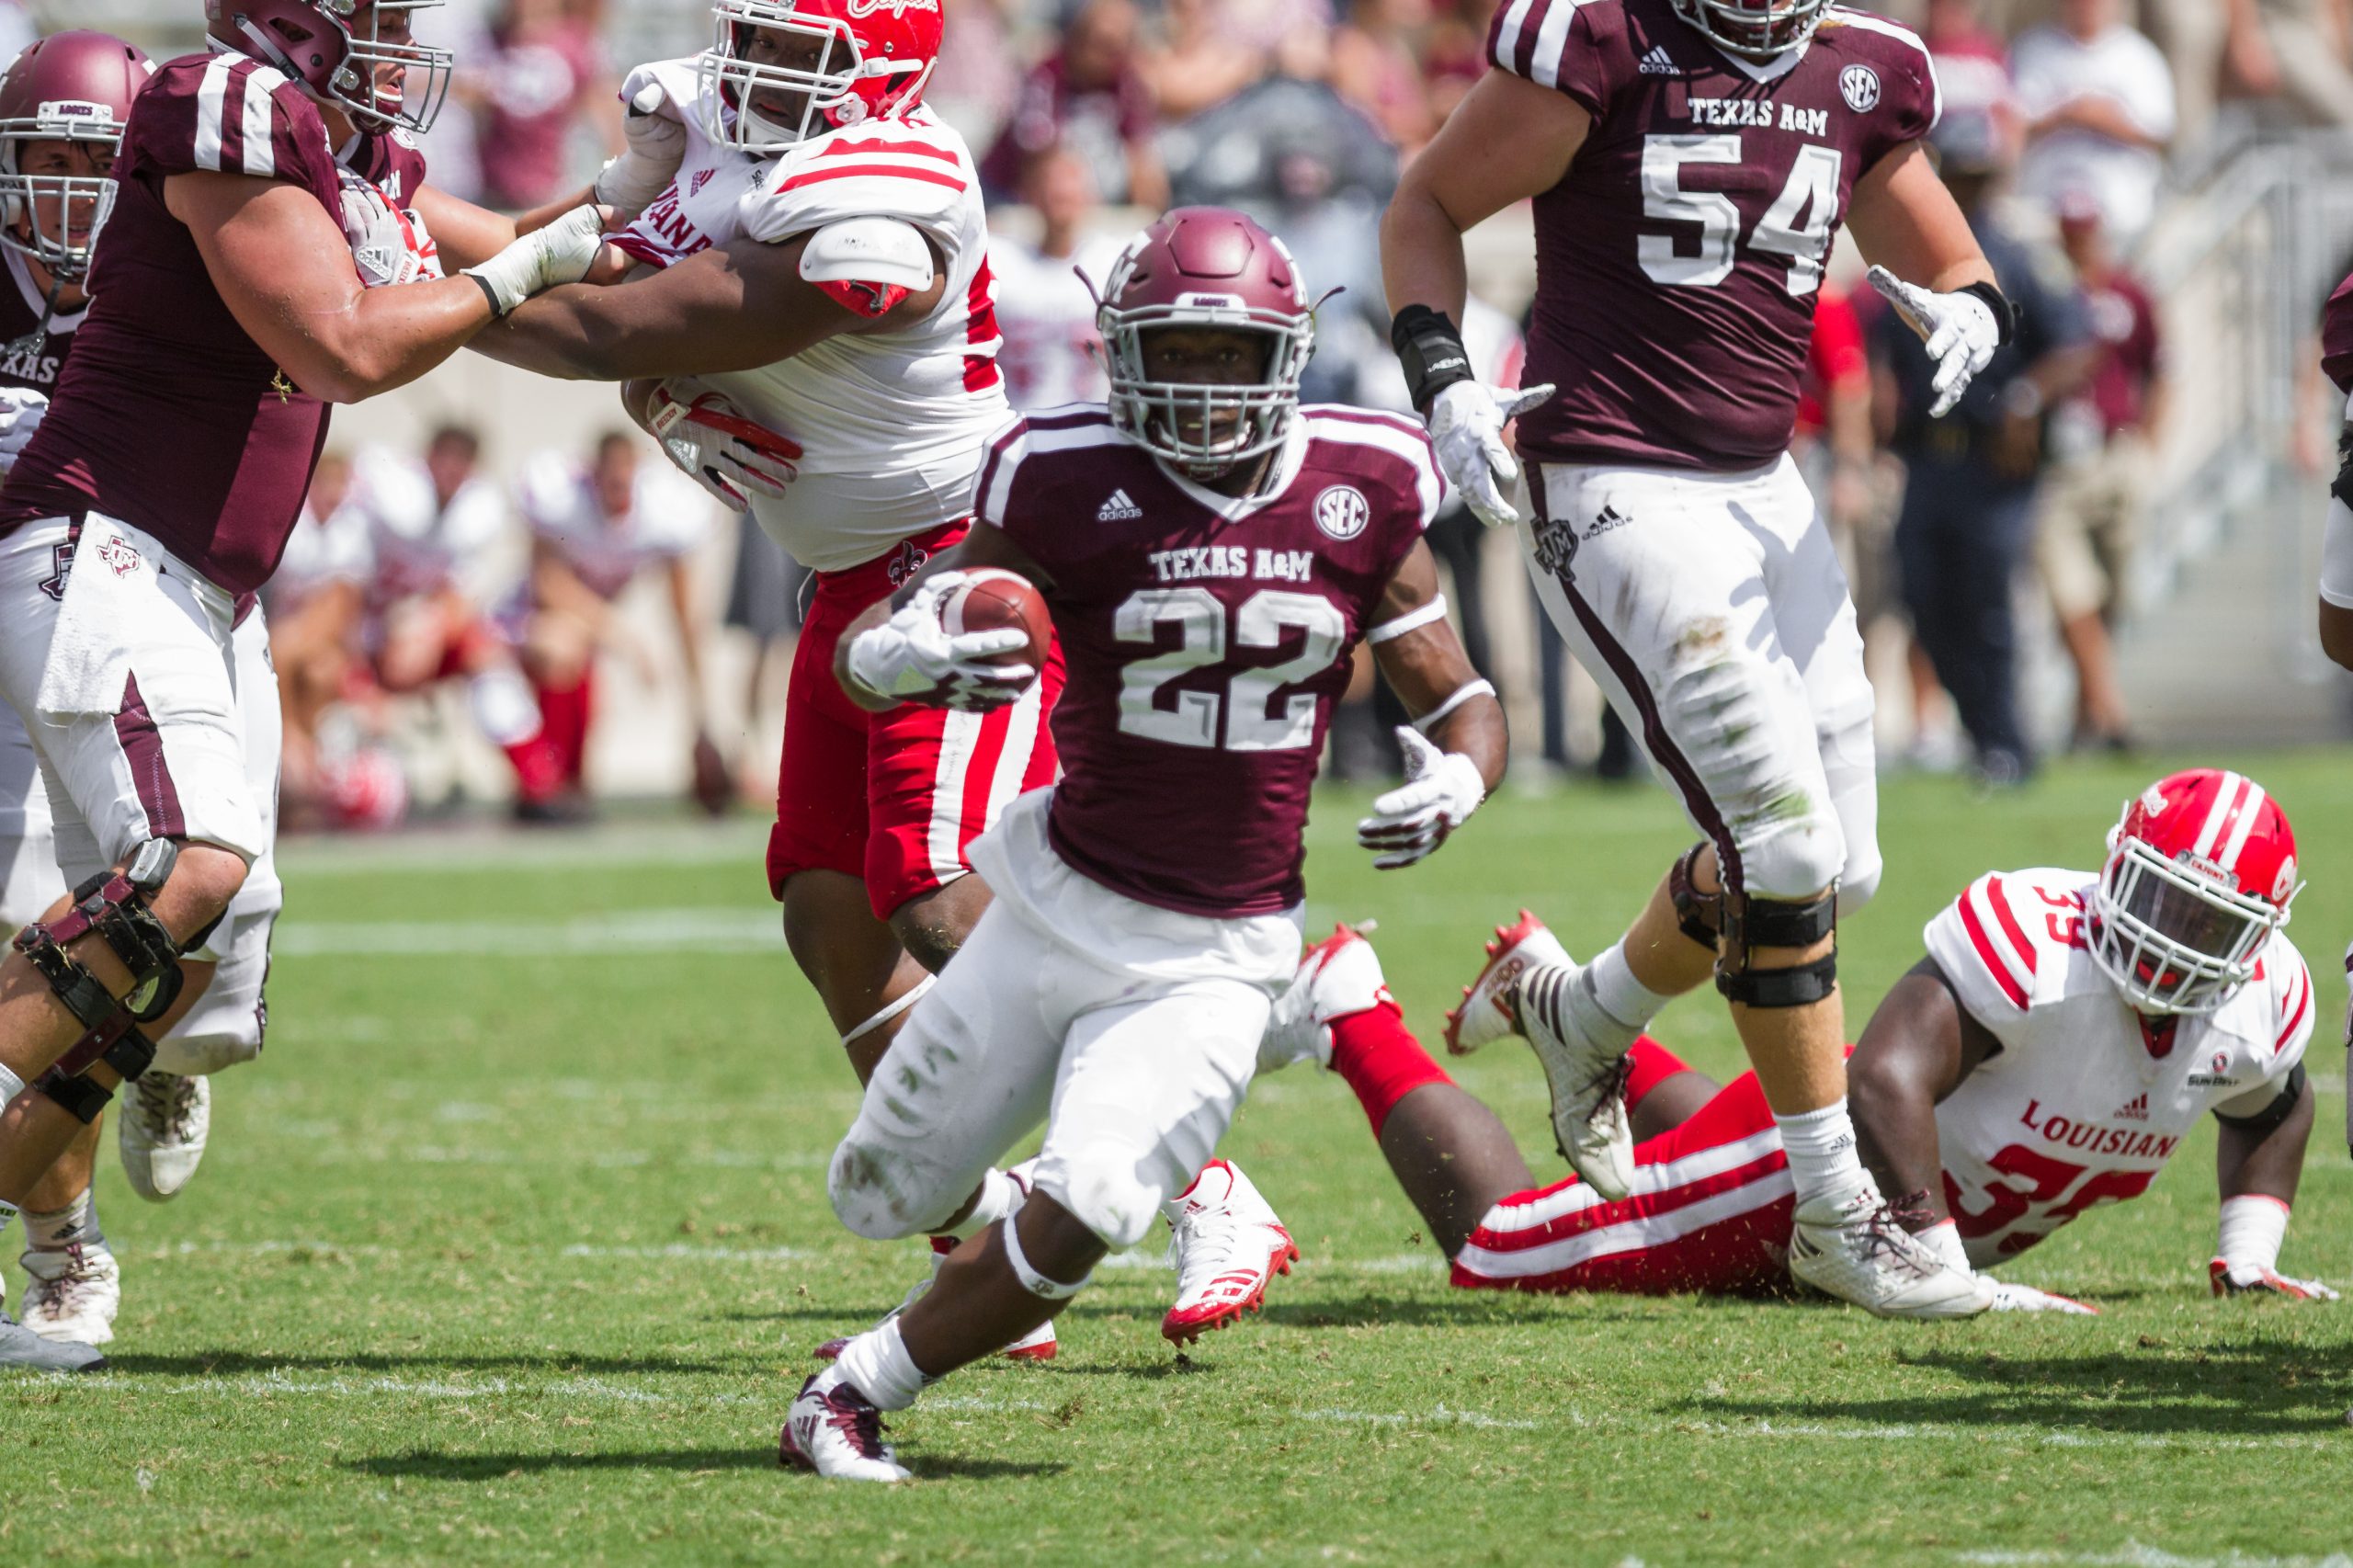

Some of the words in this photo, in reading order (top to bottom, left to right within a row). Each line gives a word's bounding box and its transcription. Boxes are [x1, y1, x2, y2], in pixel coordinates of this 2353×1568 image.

[1843, 67, 1878, 109] SEC
[1688, 98, 1773, 127] TEXAS
[1779, 103, 1828, 137] A&M
[1637, 134, 1842, 297] 54
[358, 251, 392, 278] adidas
[0, 350, 59, 383] XAS
[1098, 506, 1142, 521] adidas
[1321, 490, 1365, 535] SEC
[1150, 546, 1247, 581] TEXAS
[1252, 549, 1313, 582] A&M
[1113, 586, 1346, 752] 22
[2019, 1098, 2179, 1160] LOUISIAN
